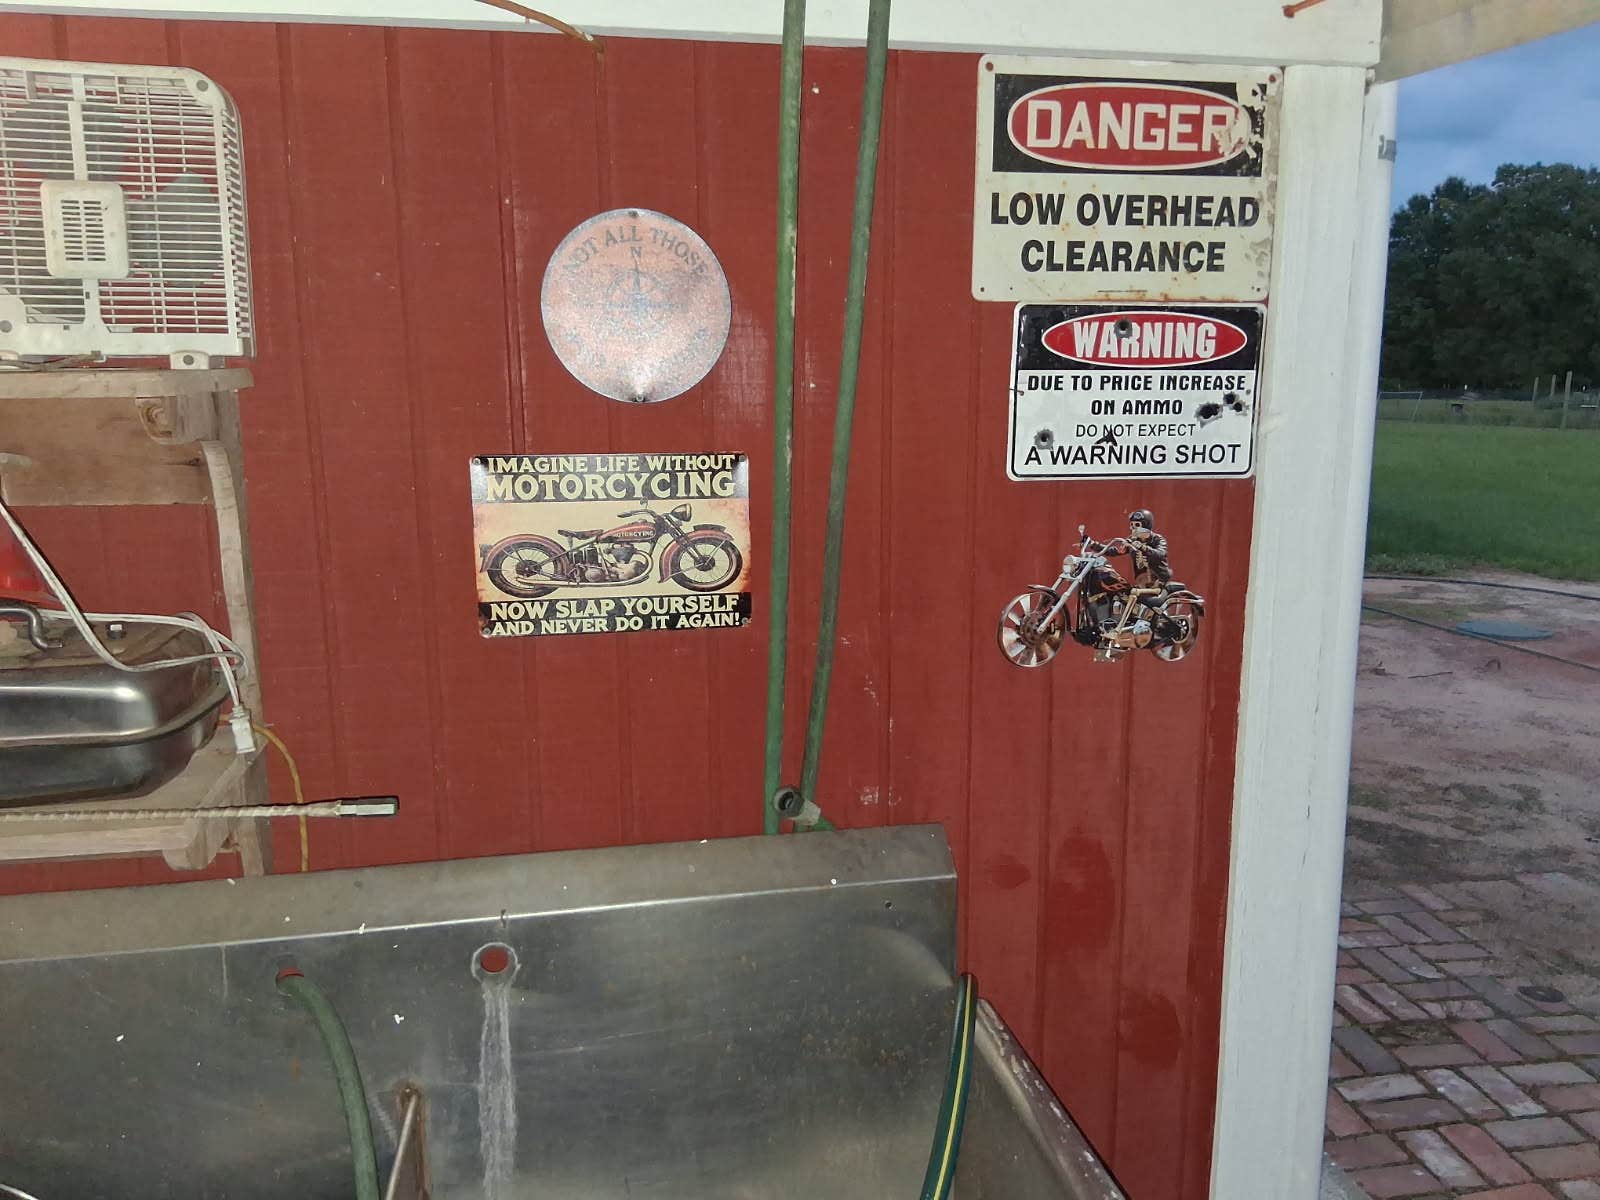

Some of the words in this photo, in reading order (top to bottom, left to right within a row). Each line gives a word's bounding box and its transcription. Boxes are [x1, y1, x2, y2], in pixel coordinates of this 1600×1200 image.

[1026, 100, 1237, 152] DANGER
[991, 192, 1065, 225] LOW
[1076, 193, 1260, 228] OVERHEAD
[604, 225, 643, 247] ALL
[1021, 239, 1226, 273] CLEARANCE
[1073, 321, 1217, 359] WARNING
[1027, 375, 1064, 391] DUE
[1071, 375, 1092, 391] TO
[1100, 375, 1153, 391] PRICE
[1159, 375, 1246, 391] INCREASE
[1091, 399, 1115, 415] ON
[1122, 399, 1183, 415] AMMO
[1075, 424, 1098, 437] DO
[1103, 424, 1134, 437] NOT
[1138, 423, 1196, 437] EXPECT
[487, 456, 589, 474] IMAGINE
[596, 455, 641, 473] LIFE
[645, 454, 736, 472] WITHOUT
[1024, 446, 1042, 465] A
[1050, 445, 1167, 465] WARNING
[1175, 444, 1241, 464] SHOT
[490, 601, 551, 621] NOW
[556, 598, 616, 618] SLAP
[623, 594, 740, 616] YOURSELF
[491, 621, 535, 636] AND
[540, 618, 608, 634] NEVER
[616, 616, 644, 631] DO
[649, 615, 669, 629] IT
[675, 612, 741, 628] AGAIN!
